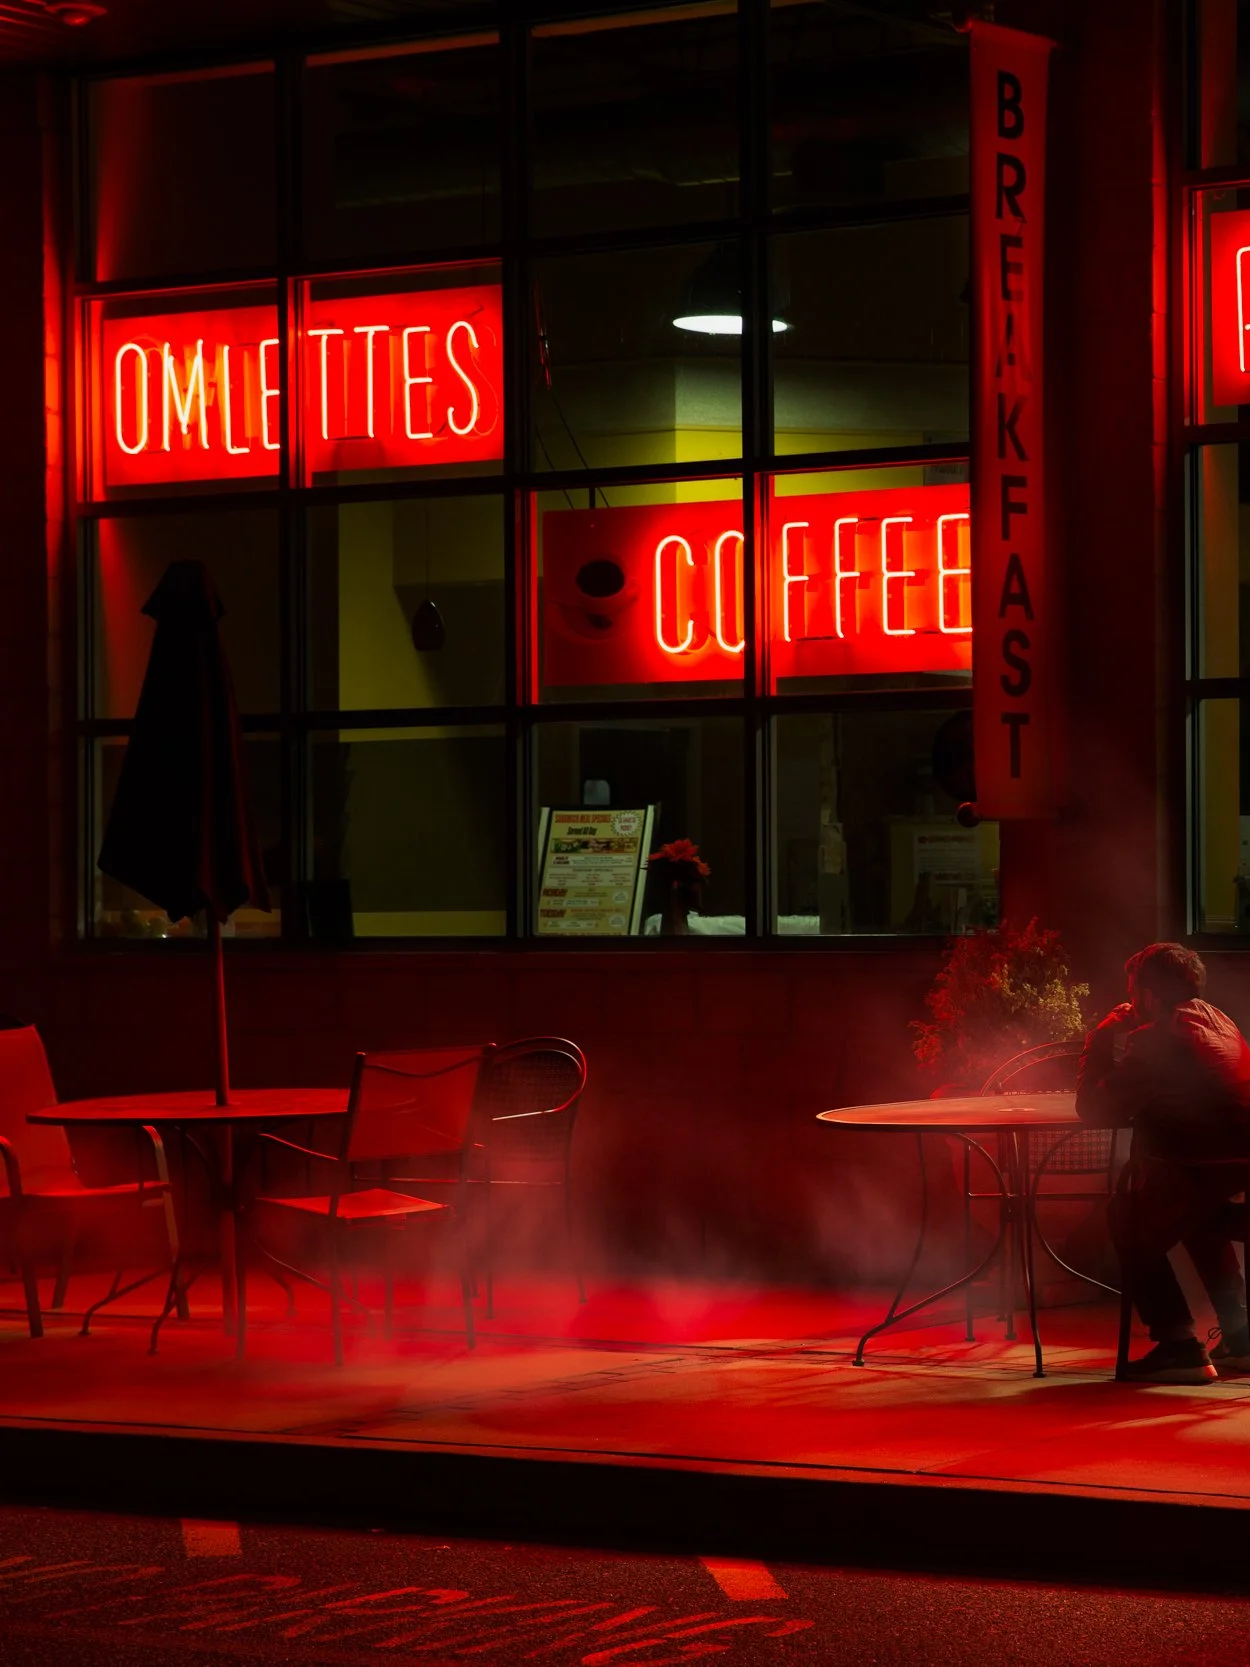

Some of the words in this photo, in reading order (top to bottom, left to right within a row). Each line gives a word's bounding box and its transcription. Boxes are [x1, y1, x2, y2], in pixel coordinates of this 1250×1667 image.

[114, 320, 480, 455] OMLETTES
[995, 69, 1034, 779] BREAKFAST
[653, 512, 973, 656] COFFEE
